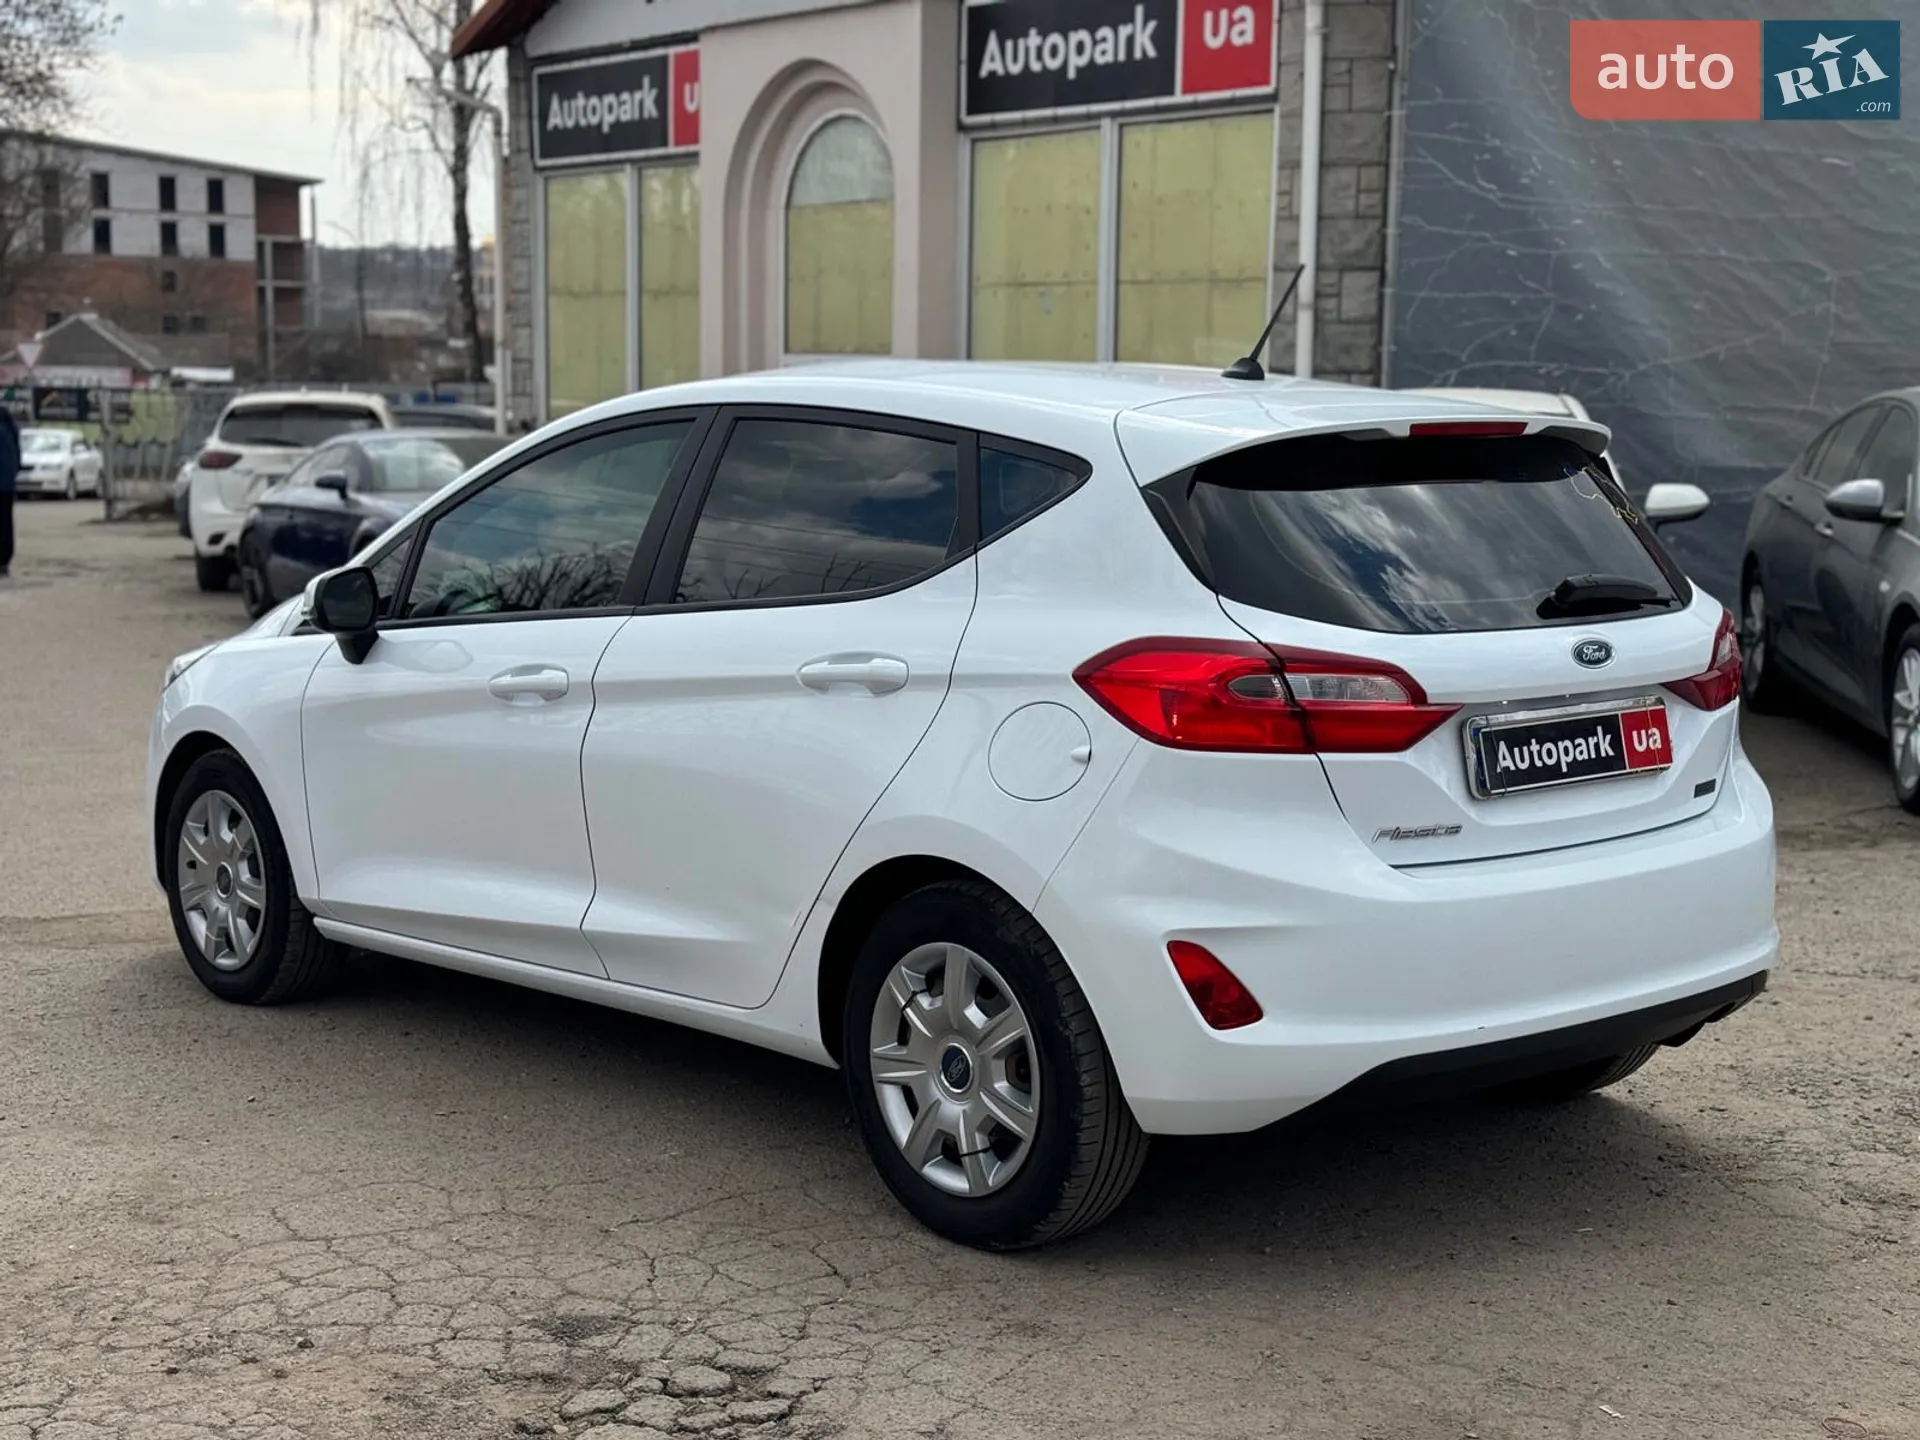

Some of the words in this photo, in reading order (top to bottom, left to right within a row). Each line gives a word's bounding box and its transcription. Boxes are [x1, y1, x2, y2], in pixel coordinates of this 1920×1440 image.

[978, 4, 1158, 80] Autopark
[1203, 5, 1255, 49] ua
[546, 74, 659, 134] Autopark
[1582, 645, 1606, 661] Ford
[1496, 725, 1615, 773] Autopark
[1632, 727, 1662, 752] ua
